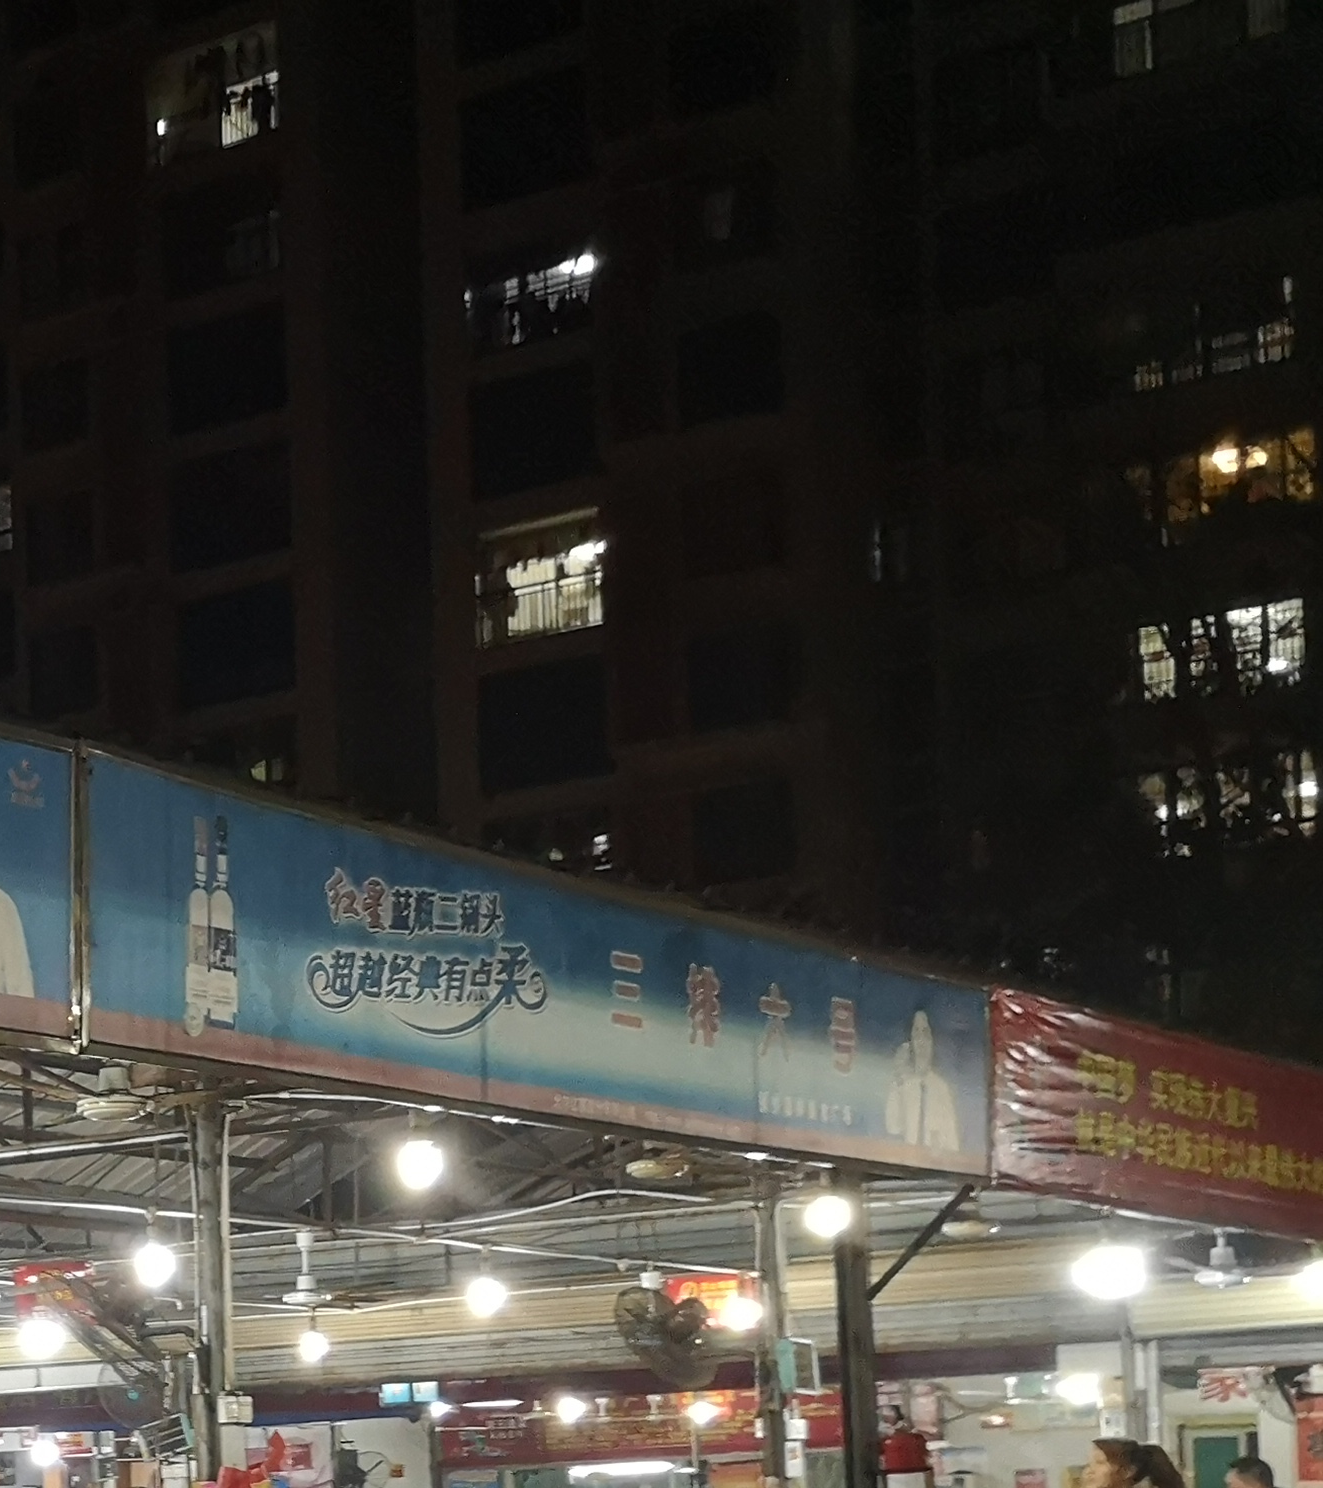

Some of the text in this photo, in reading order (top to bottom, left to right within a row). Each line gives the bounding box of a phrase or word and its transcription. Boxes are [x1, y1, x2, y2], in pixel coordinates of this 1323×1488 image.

[327, 941, 533, 1013] 超越经典有点柔
